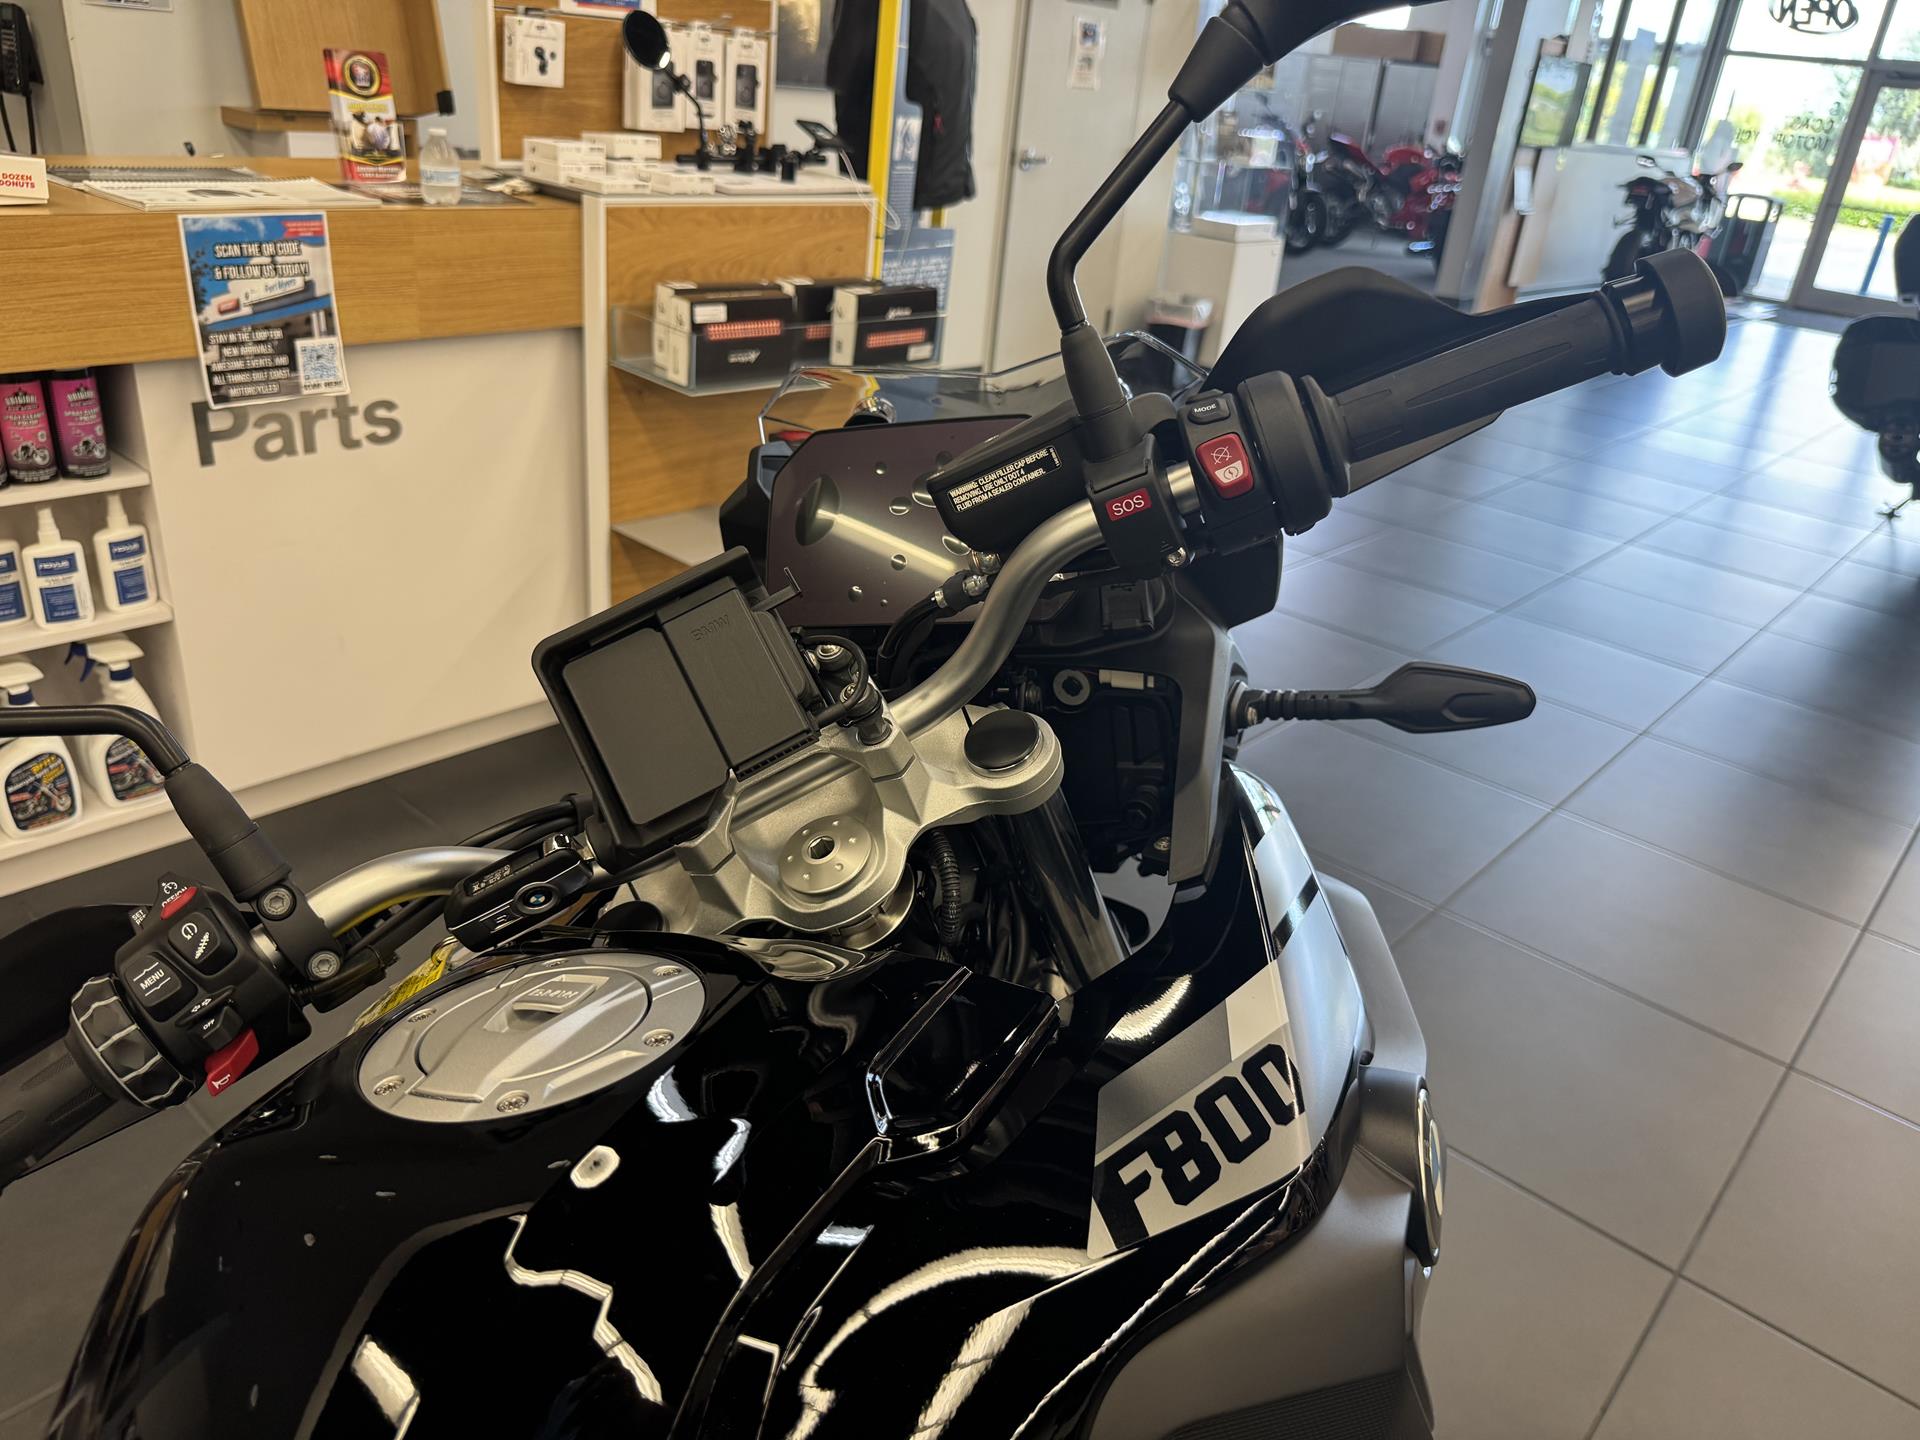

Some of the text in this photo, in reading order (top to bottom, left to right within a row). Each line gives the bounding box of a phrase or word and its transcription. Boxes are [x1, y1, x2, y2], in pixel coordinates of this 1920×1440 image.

[0, 180, 35, 189] DONUTS
[2, 173, 32, 181] DOZEN
[214, 240, 302, 258] SCAN THE QR CODE
[223, 265, 262, 279] FOLLOW
[262, 264, 276, 278] US
[276, 263, 309, 277] TODAY!
[208, 334, 228, 344] STAY
[1194, 403, 1217, 413] MODE
[191, 395, 402, 467] Parts
[949, 481, 979, 498] WARNING:
[978, 472, 997, 486] CLEAN
[996, 465, 1015, 479] FILLER
[1014, 460, 1026, 471] CAP
[1025, 449, 1049, 464] BEFORE
[982, 482, 995, 493] USE
[994, 475, 1009, 487] ONLY
[1008, 471, 1021, 482] DOT
[956, 500, 973, 512] FLUID
[972, 493, 989, 506] FROM
[992, 482, 1014, 498] SEALED
[1012, 467, 1047, 487] CONTAINER.
[1112, 495, 1145, 516] SOS
[689, 614, 730, 641] BMW
[131, 909, 144, 921] SET
[139, 969, 165, 990] MENU
[528, 988, 579, 999] BMW
[203, 1018, 216, 1030] OFF
[1092, 1044, 1305, 1250] F800
